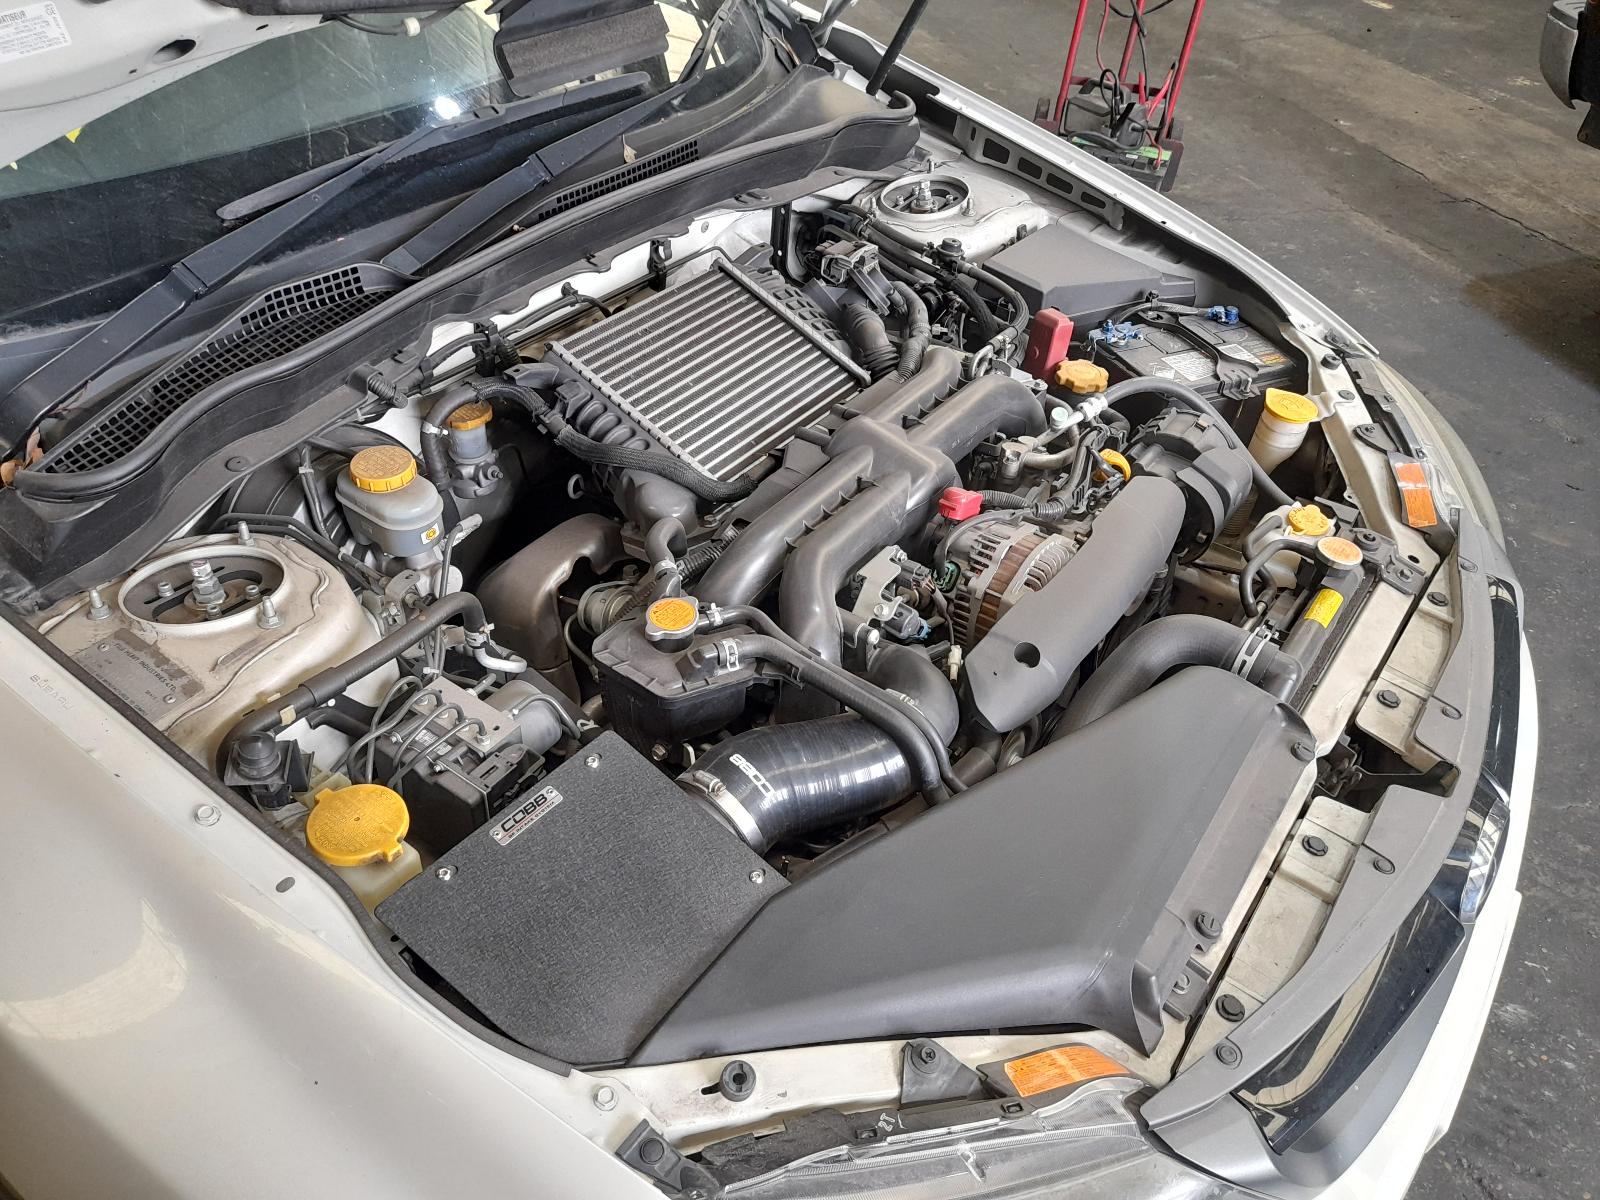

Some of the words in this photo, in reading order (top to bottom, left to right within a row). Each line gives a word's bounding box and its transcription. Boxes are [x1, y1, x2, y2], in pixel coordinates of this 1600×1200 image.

[0, 10, 26, 24] ATISEUR
[139, 660, 166, 682] INDUSTRIES
[728, 753, 776, 798] COBB
[501, 793, 548, 832] COBB
